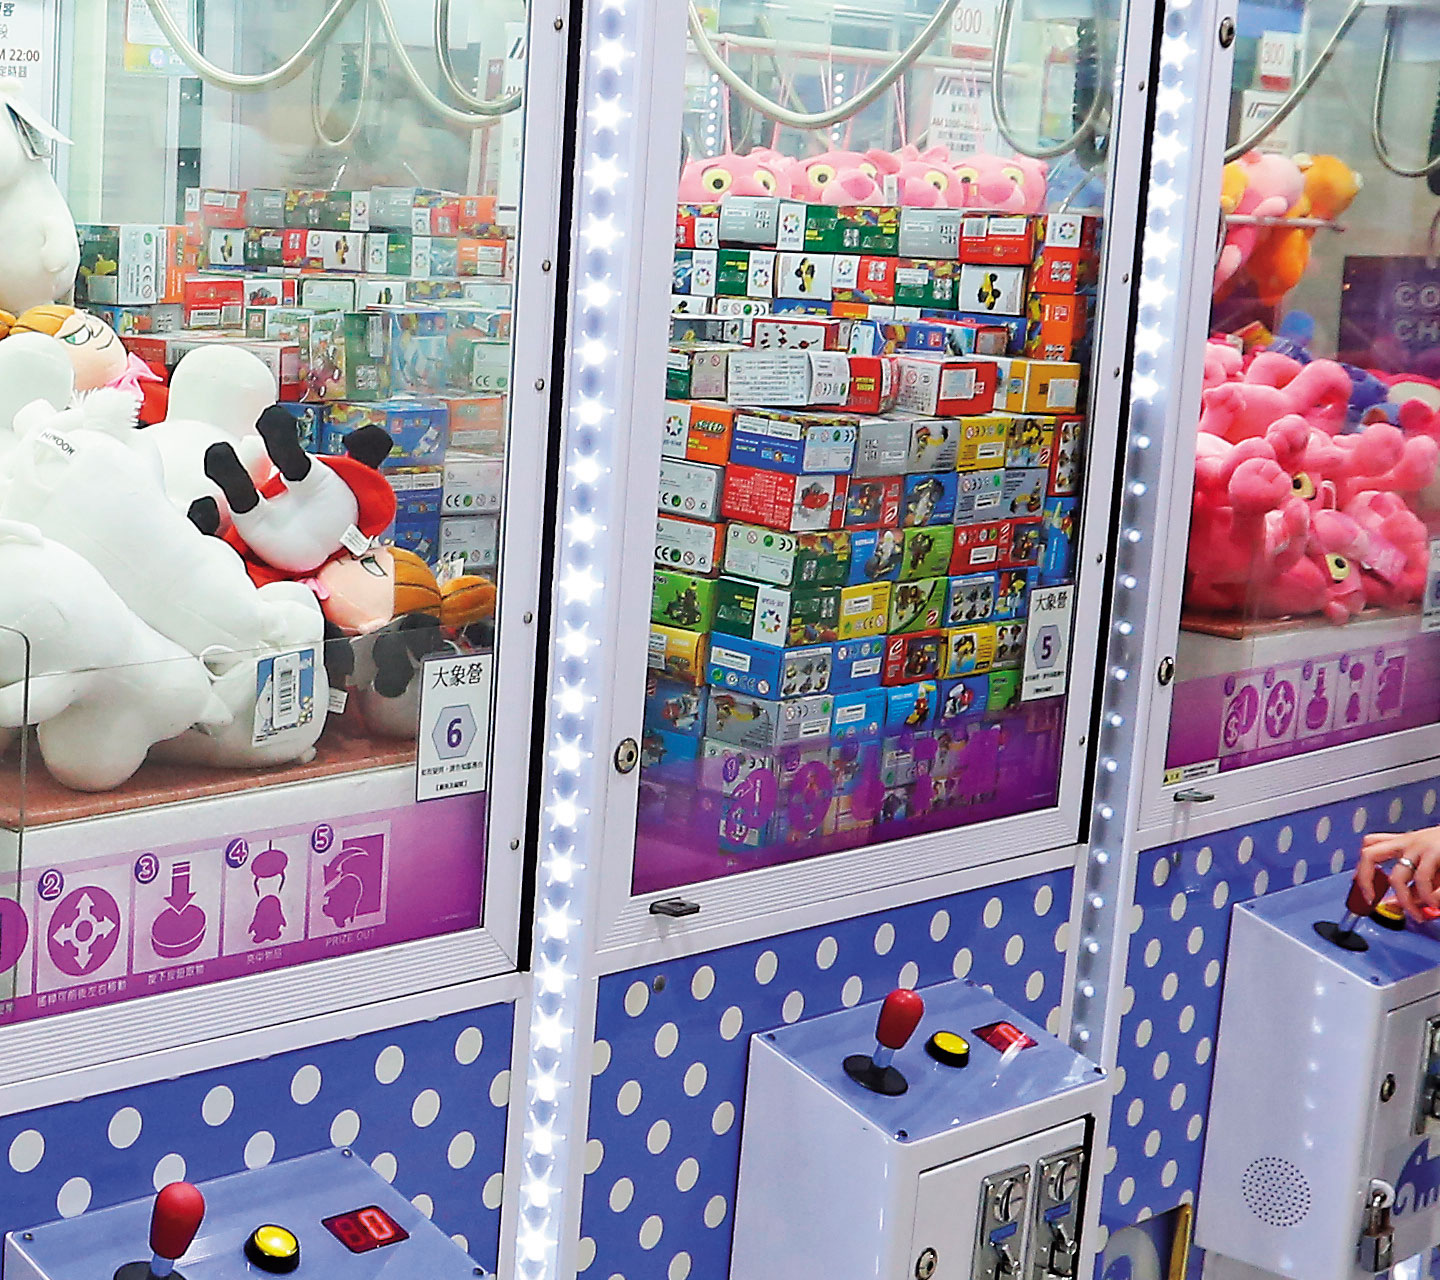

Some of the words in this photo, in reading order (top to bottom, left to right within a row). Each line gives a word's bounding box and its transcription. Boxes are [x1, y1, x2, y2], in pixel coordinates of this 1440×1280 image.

[9, 49, 40, 62] 22:00
[1041, 636, 1051, 660] 5
[432, 663, 483, 689] 大象營
[447, 718, 462, 748] 6
